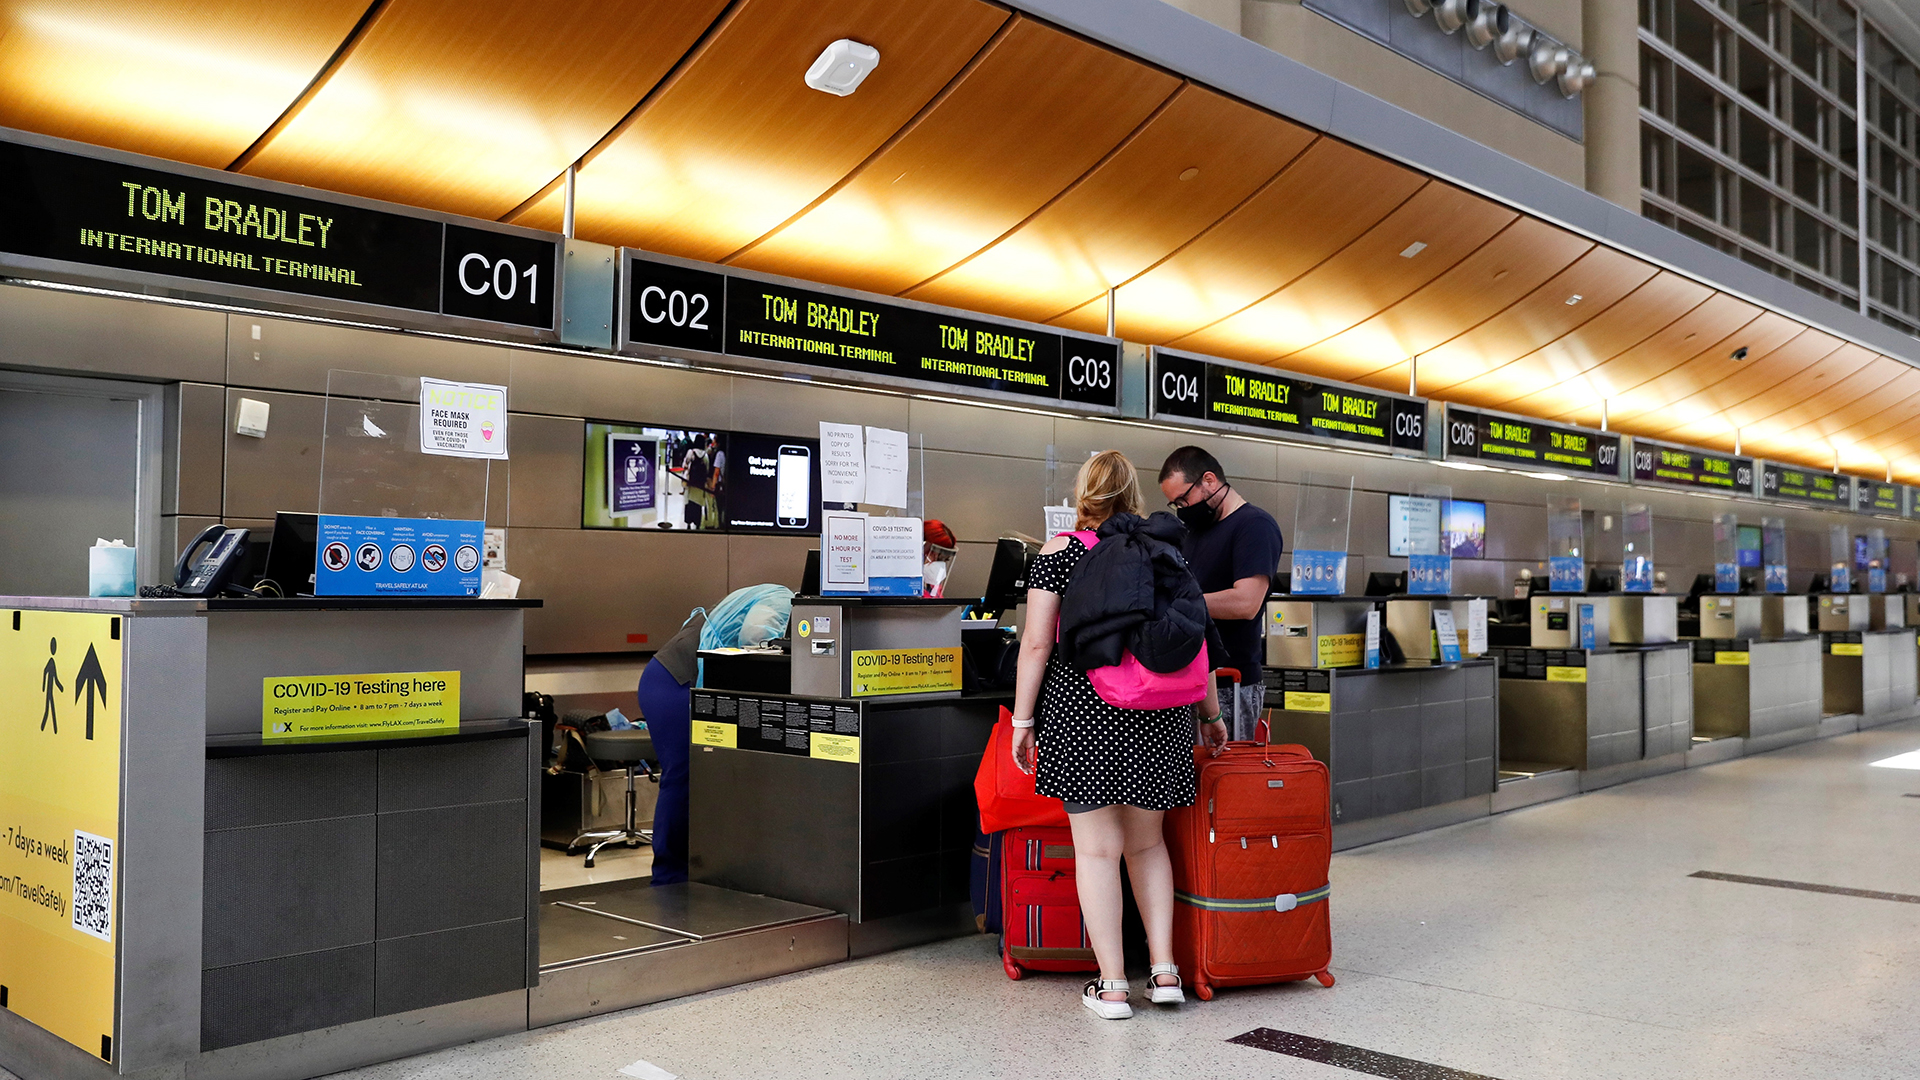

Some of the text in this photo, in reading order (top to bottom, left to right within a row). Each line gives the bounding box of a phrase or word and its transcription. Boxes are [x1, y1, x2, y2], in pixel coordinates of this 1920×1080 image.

[122, 182, 333, 248] TOM BRADLEY
[80, 228, 362, 286] INTERNATIONAL TERMINAL
[459, 253, 537, 304] C01
[640, 286, 709, 330] C02
[762, 294, 880, 338] TOM BRADLEY
[740, 330, 897, 364] INTERNATIONAL TERMINAL
[940, 324, 1035, 362] TOM BRADLEY
[921, 357, 1049, 387] INTERNATIONAL TERMINAL
[1069, 356, 1111, 389] C03
[1162, 372, 1199, 403] C04
[1225, 375, 1290, 405] TOM BRADLEY
[429, 389, 499, 410] NOTICE
[1322, 392, 1378, 419] TOM BRADLEY
[432, 409, 470, 420] FACE MASK
[434, 419, 468, 429] REQUIRED
[1214, 402, 1299, 425] INTERNATIONAL TERMINAL
[1312, 417, 1384, 438] INTERNATIONAL TERMINAL
[1396, 412, 1422, 438] C05
[1452, 422, 1475, 446] C06
[1490, 422, 1531, 444] TOM BRADLEY
[1551, 432, 1588, 452] TOM BRADLEY
[748, 456, 778, 467] Get your
[1598, 445, 1617, 465] C07
[1635, 451, 1652, 471] C08
[1320, 638, 1360, 648] COVID-19 Testing
[857, 652, 954, 667] COVID-19 Testing here
[274, 678, 446, 698] COVID-19 Testing here
[857, 684, 868, 692] LAX
[274, 707, 301, 716] Register
[316, 705, 328, 713] Pay
[329, 704, 350, 712] Online
[409, 701, 422, 709] days
[273, 722, 292, 733] LAX
[370, 718, 445, 727] www.FlyLAX.com/TravelSafely
[8, 827, 14, 846] 7
[15, 825, 35, 858] days
[37, 841, 42, 856] a
[44, 839, 69, 865] week
